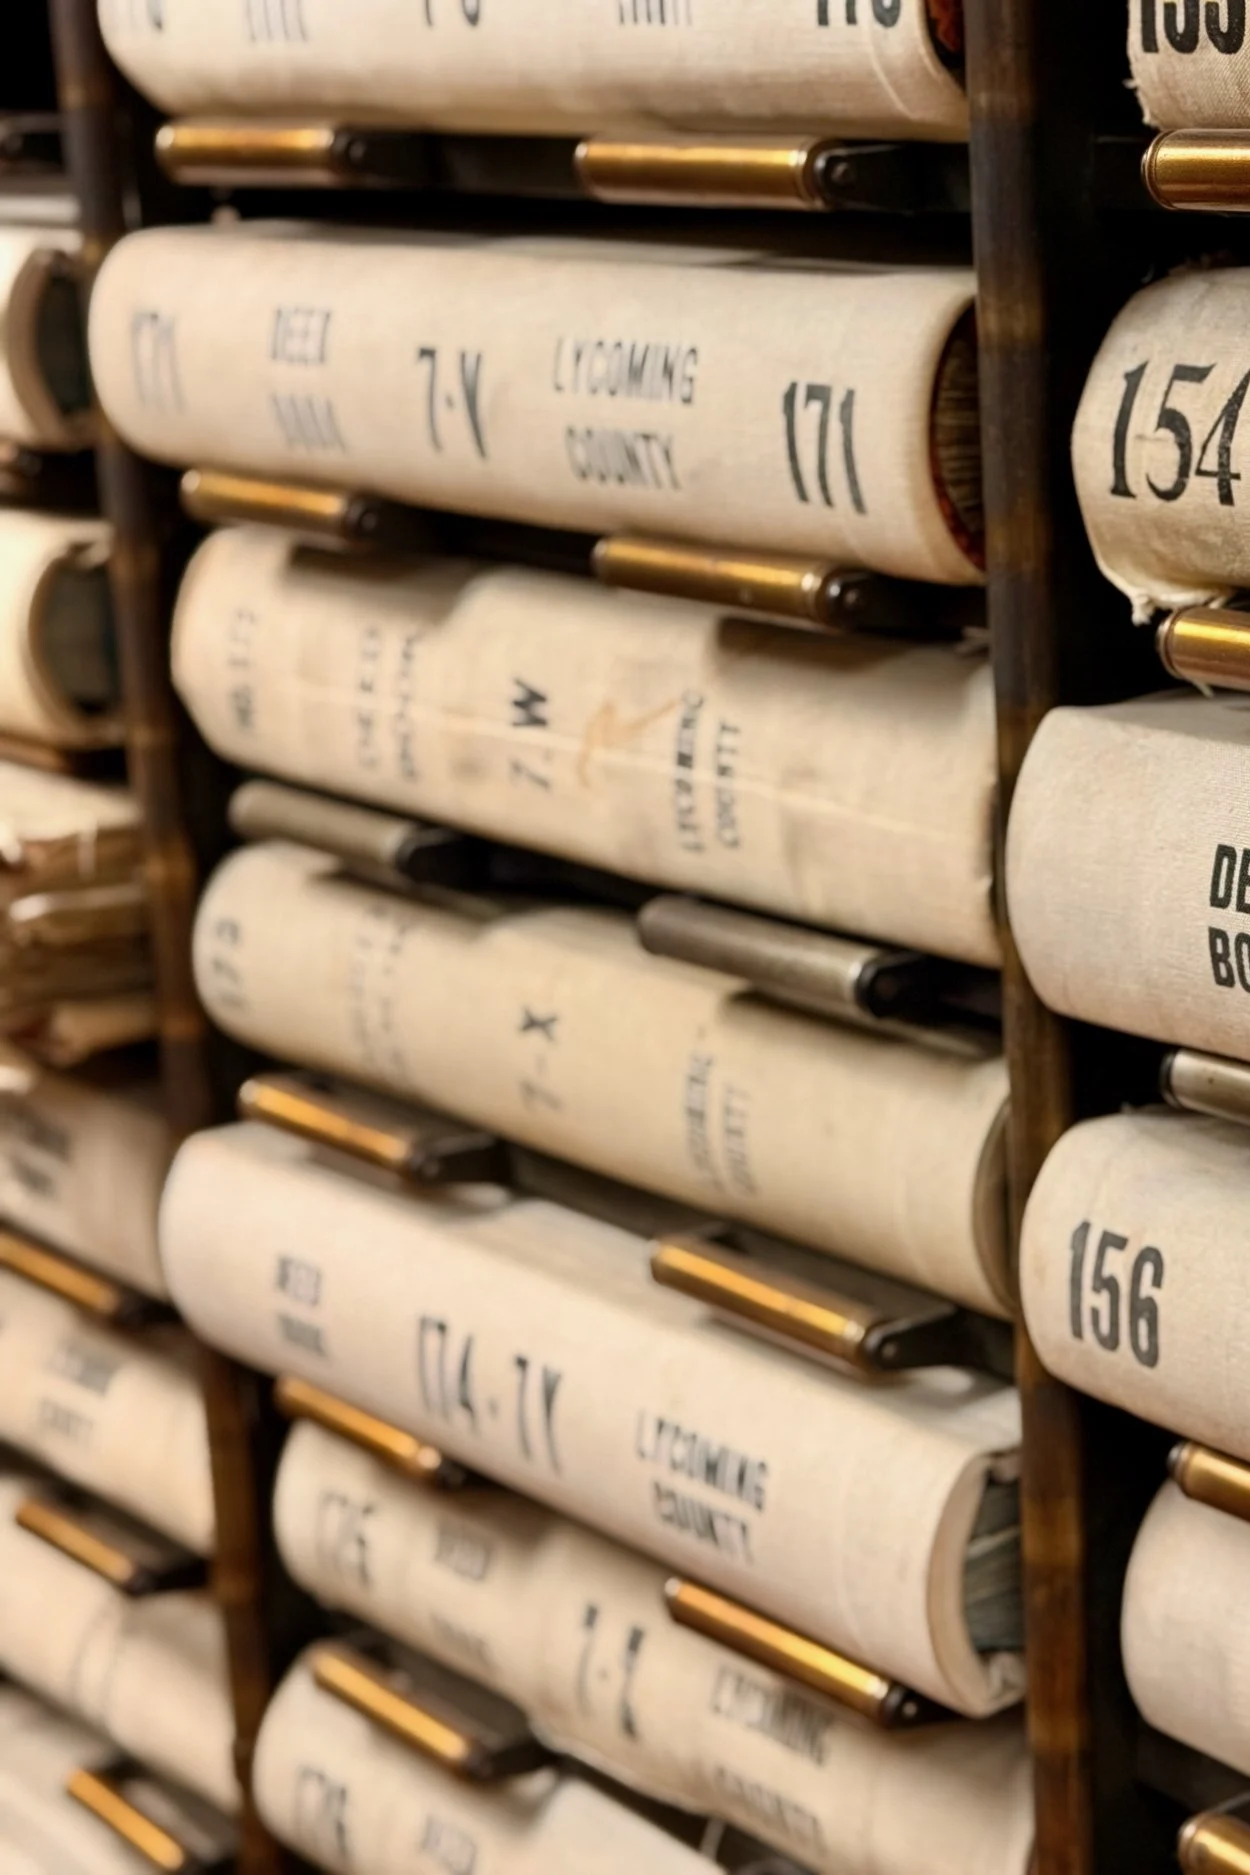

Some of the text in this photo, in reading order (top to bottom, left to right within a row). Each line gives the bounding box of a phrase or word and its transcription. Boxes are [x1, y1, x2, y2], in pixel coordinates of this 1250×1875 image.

[553, 336, 698, 405] LYCOMING
[565, 425, 683, 491] COUNTY
[782, 381, 868, 516] 171
[1069, 1220, 1165, 1370] 156
